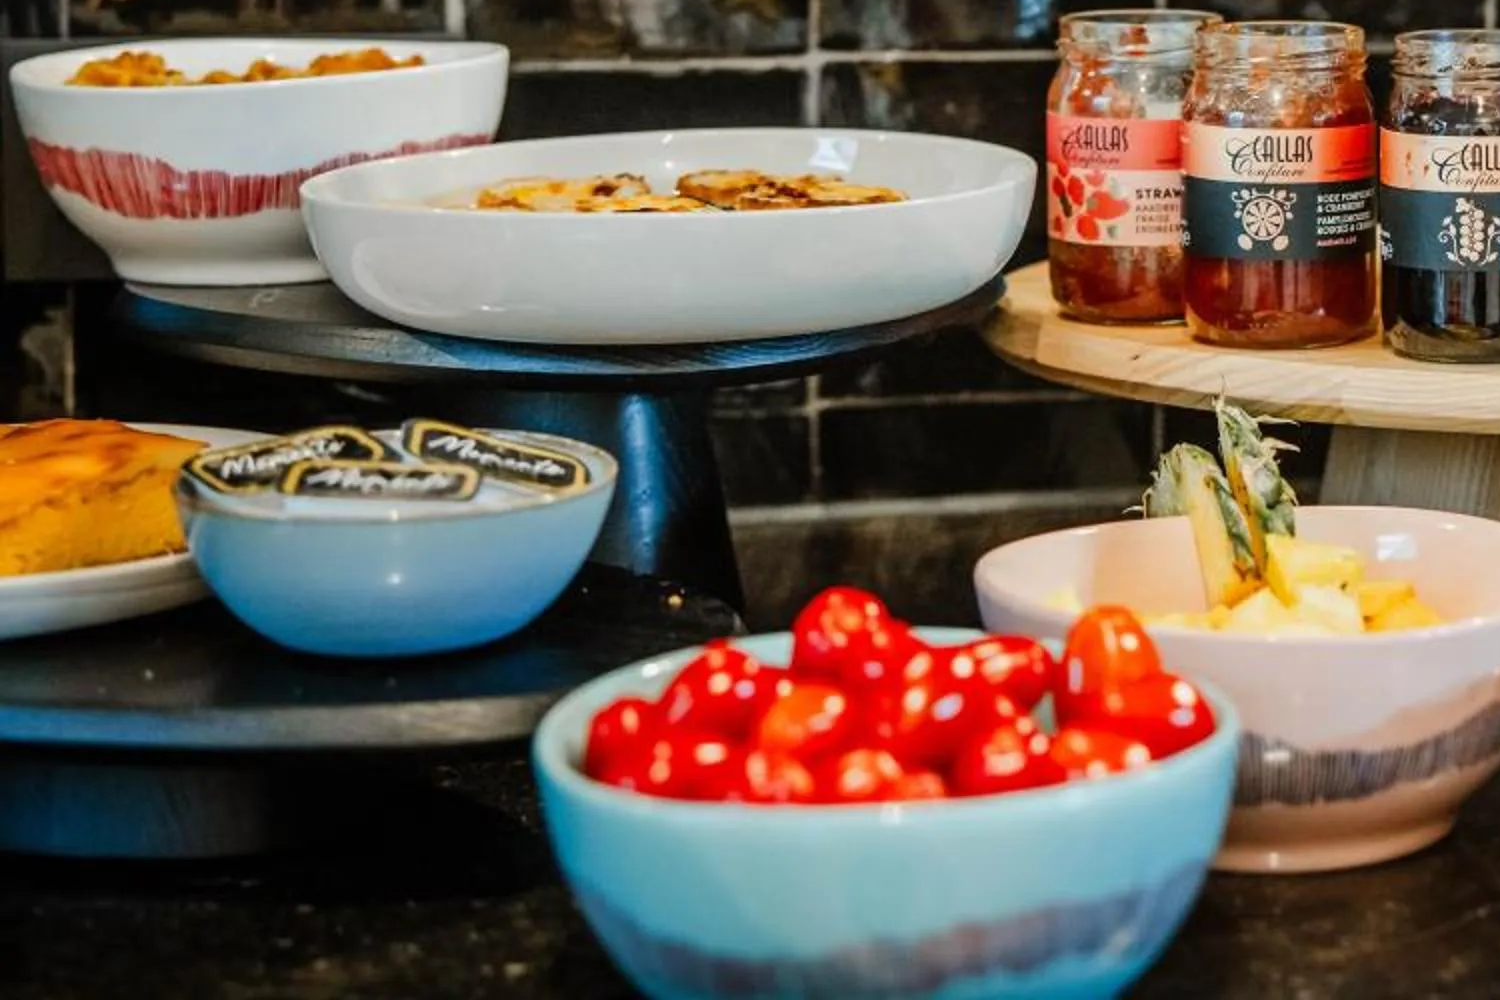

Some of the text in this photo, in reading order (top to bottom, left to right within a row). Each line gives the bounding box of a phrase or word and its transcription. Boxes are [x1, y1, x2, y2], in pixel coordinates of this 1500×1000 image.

[1075, 124, 1129, 152] CALLAS
[1253, 136, 1314, 163] CALLAS
[1135, 188, 1182, 200] STRAW
